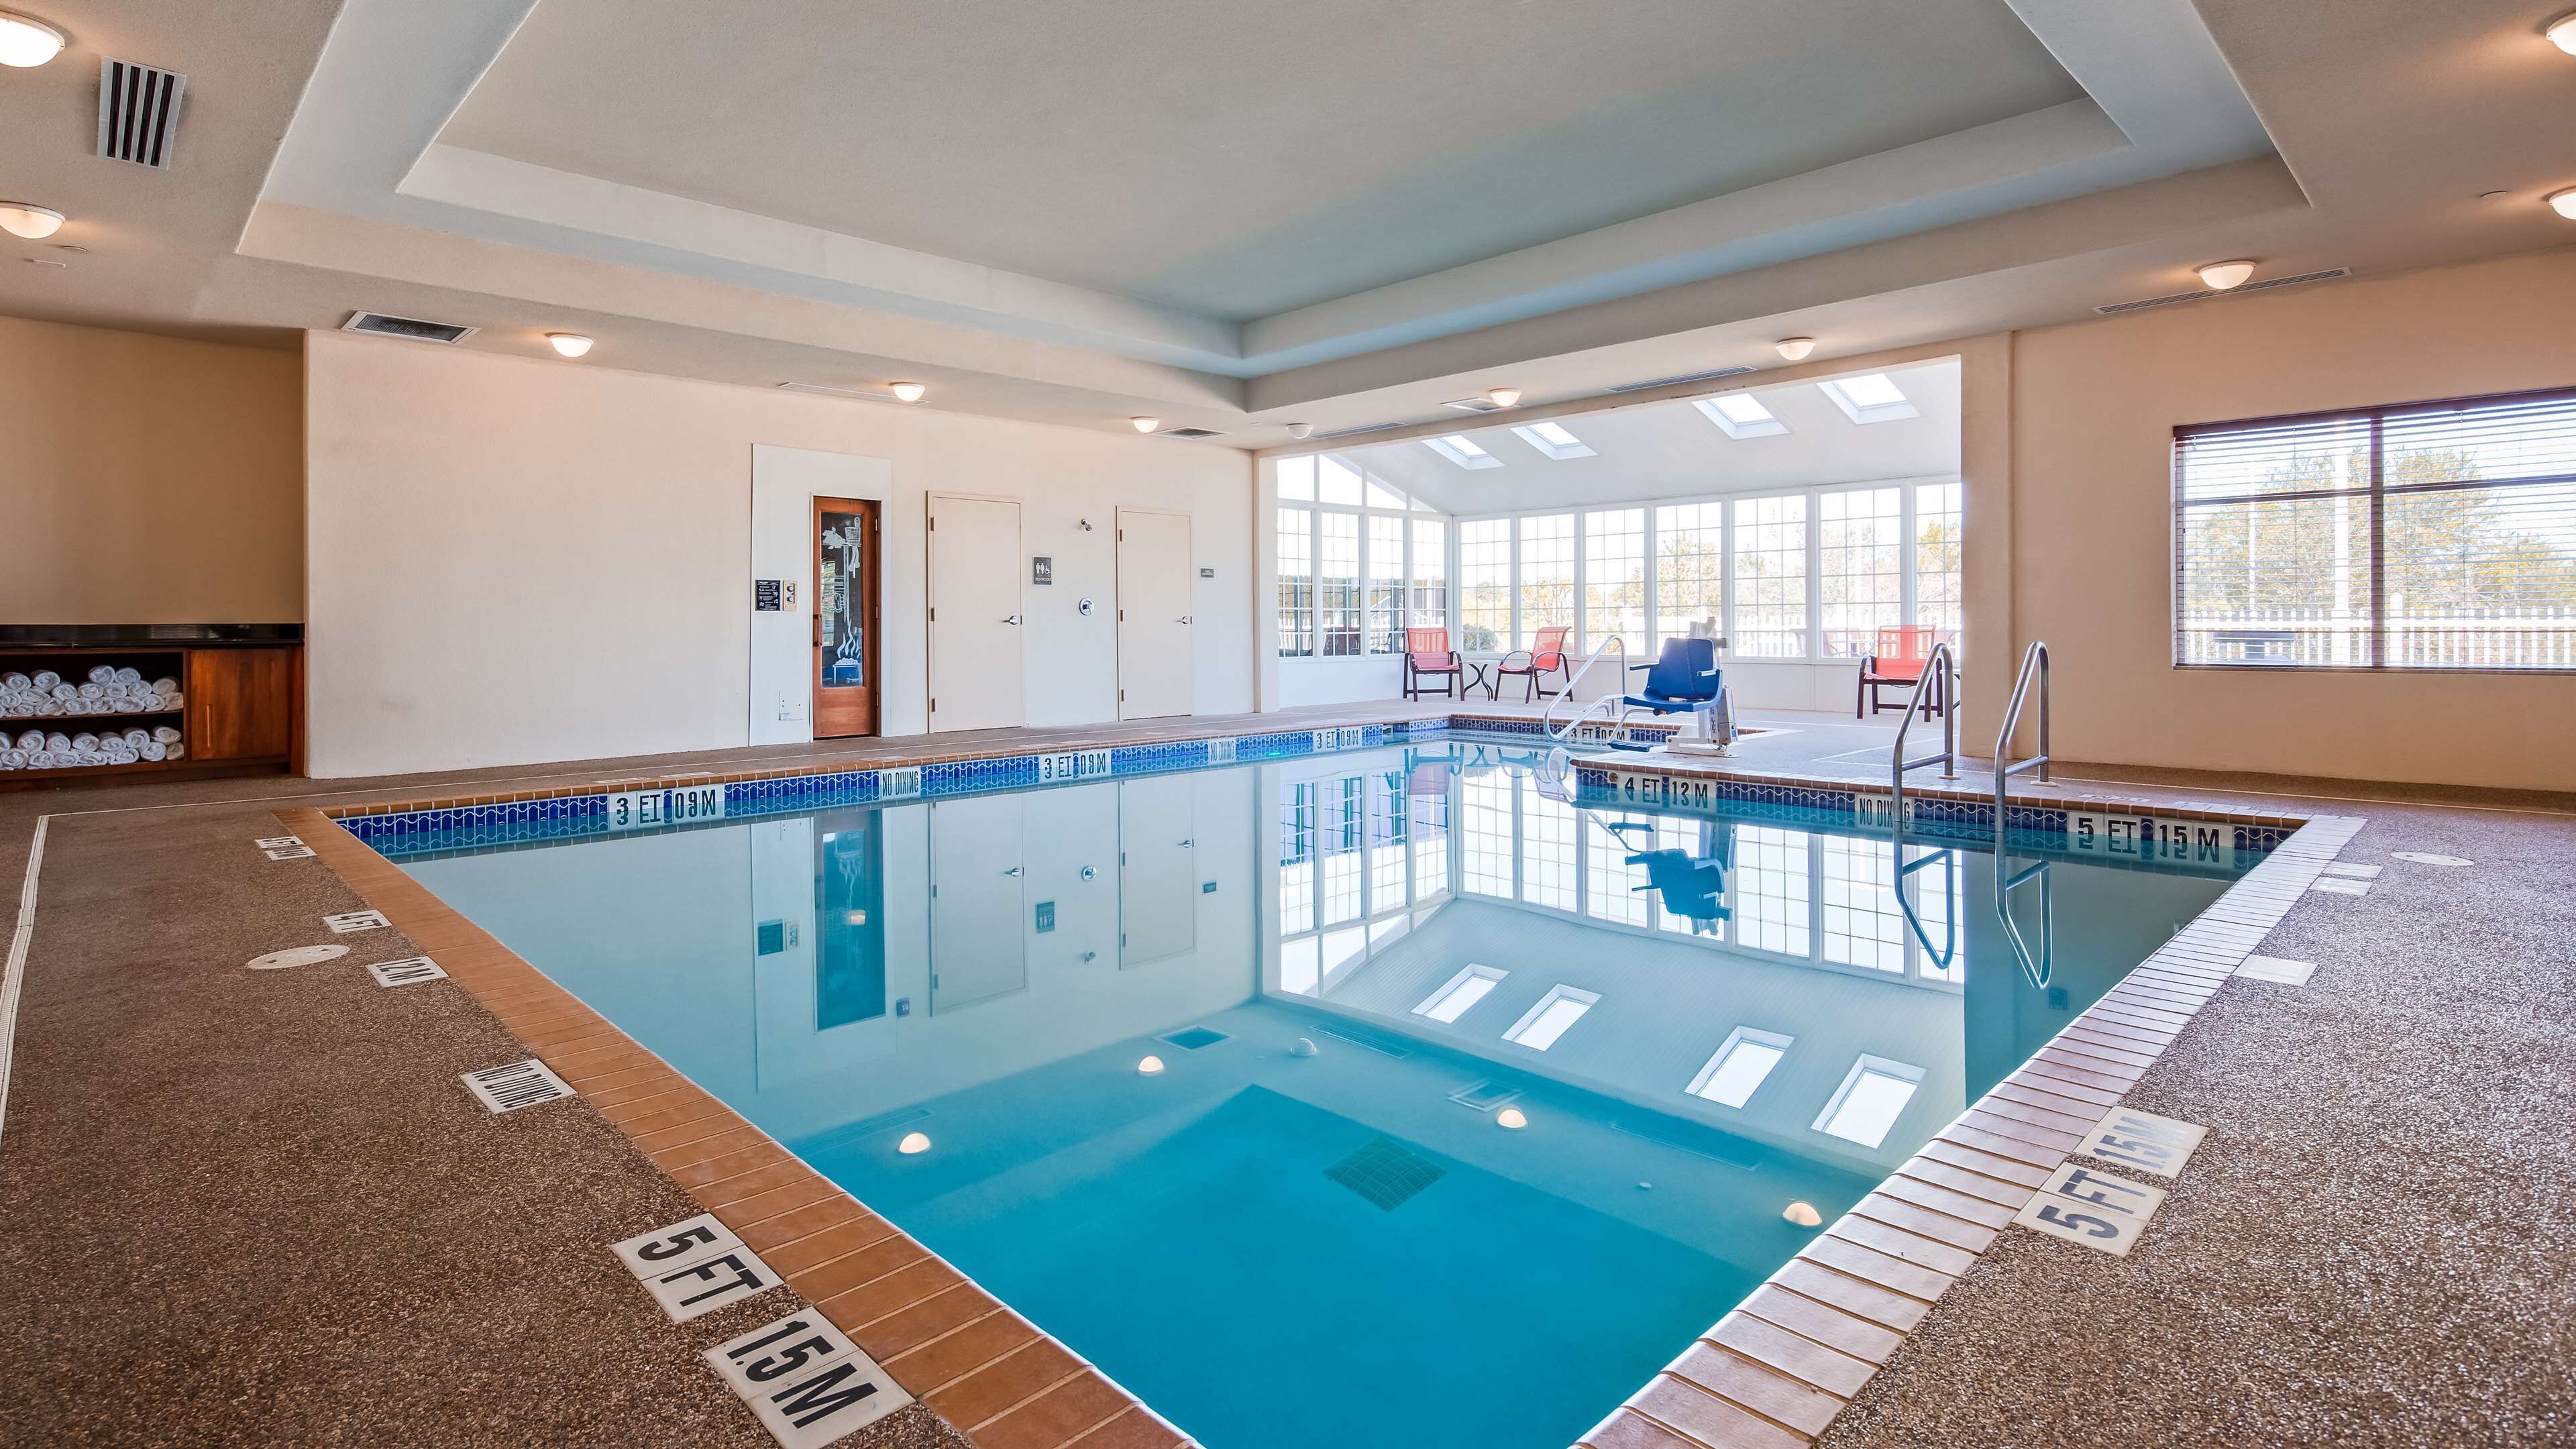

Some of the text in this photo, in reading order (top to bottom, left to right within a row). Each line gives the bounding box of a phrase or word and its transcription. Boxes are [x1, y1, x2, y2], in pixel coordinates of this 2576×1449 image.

[333, 914, 384, 931] 4 FT
[472, 1062, 563, 1109] NO DIVING
[2036, 1169, 2147, 1239] 5 FT
[637, 1226, 765, 1307] 5 FT
